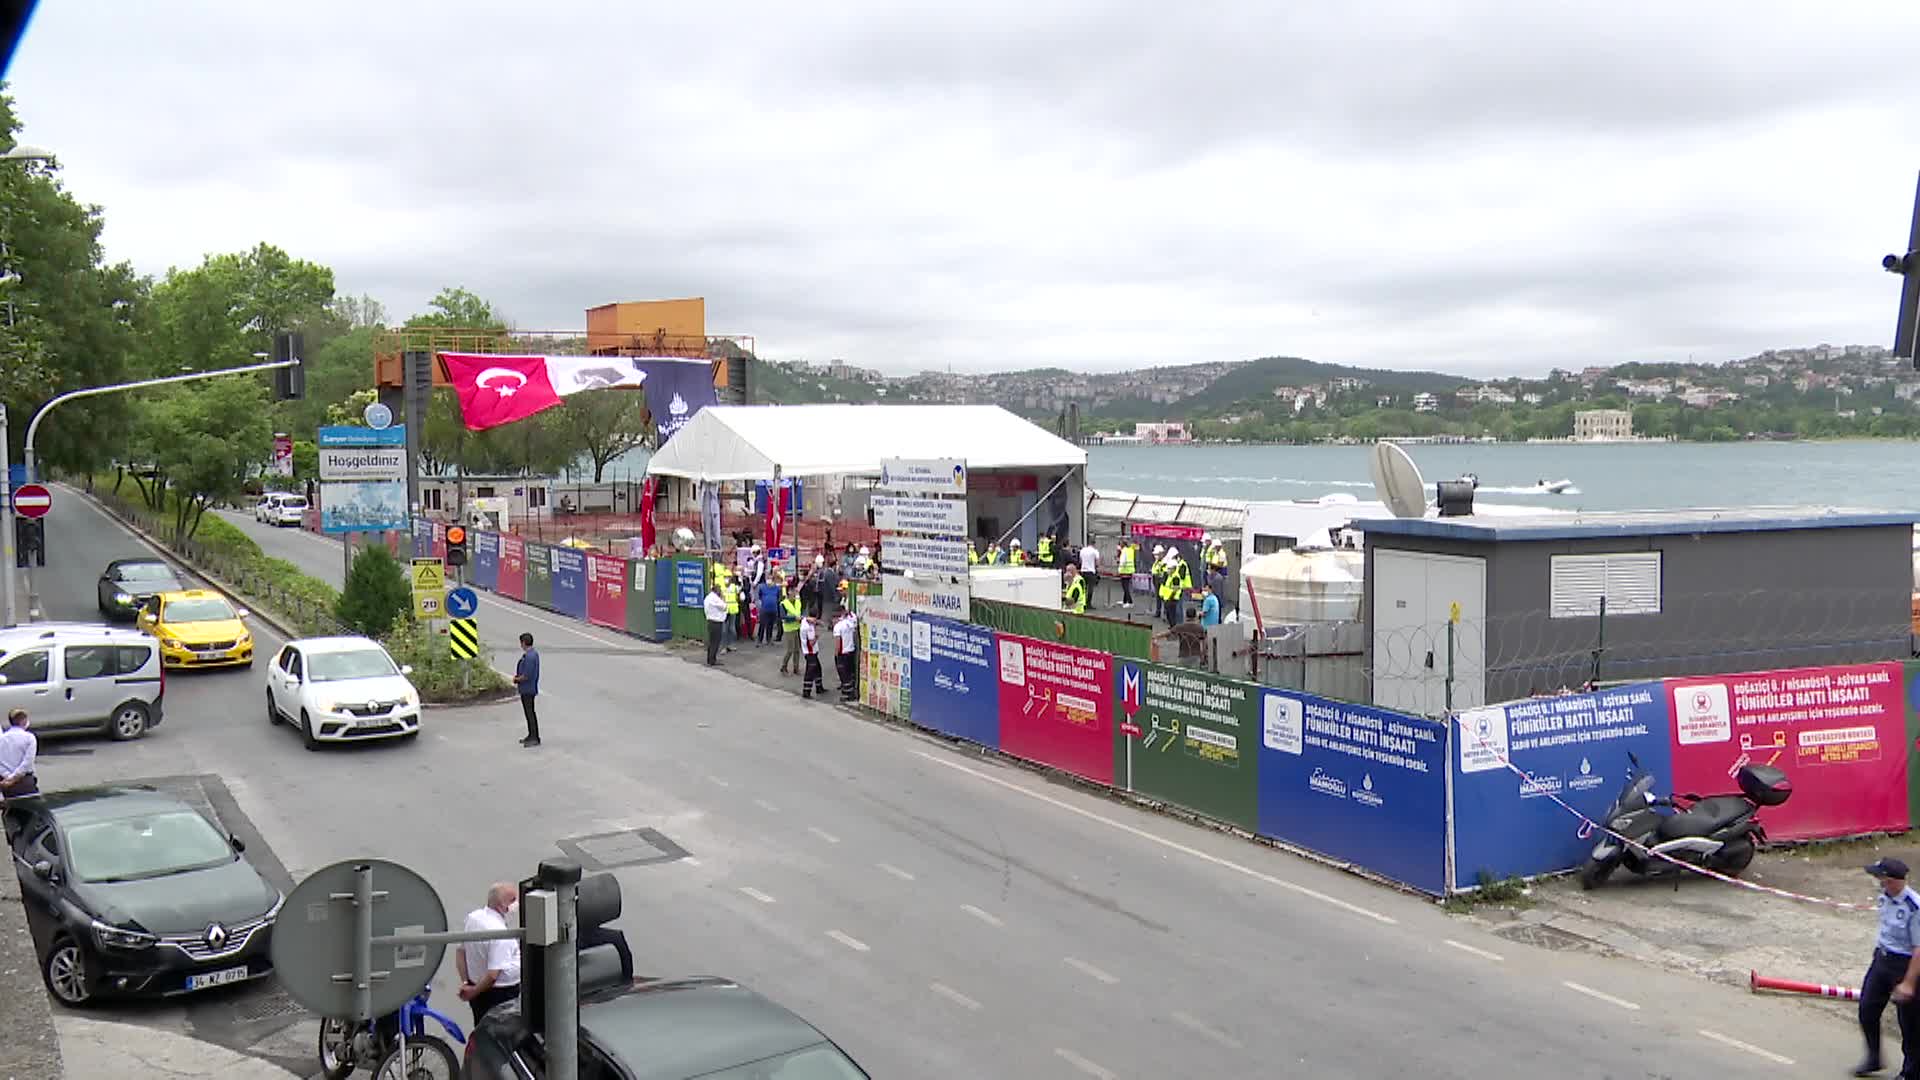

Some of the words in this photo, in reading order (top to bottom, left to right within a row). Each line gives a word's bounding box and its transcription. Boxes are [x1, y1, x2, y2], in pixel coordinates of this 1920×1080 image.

[423, 601, 437, 609] 20
[932, 593, 961, 611] ANKARA
[1123, 665, 1139, 706] M
[1733, 680, 1770, 694] BOĞAZİÇİ
[1787, 675, 1831, 690] HİSARÜSTÜ
[1837, 673, 1866, 688] AŞİYAN
[1866, 669, 1890, 685] SAHİL
[1183, 689, 1202, 705] HATTI
[1509, 702, 1541, 718] BOĞAZİÇİ
[1555, 696, 1597, 712] HİSARÜSTÜ
[1603, 692, 1629, 708] AŞİYAN
[1630, 689, 1653, 705] SAHİL
[1735, 692, 1794, 711] FÜNİKÜLER
[1796, 689, 1825, 706] HATTI
[1828, 687, 1869, 704] İNŞAATI
[1306, 703, 1334, 720] BOĞAZİÇİ
[1347, 711, 1383, 730] HİSARÜSTÜ
[1388, 720, 1413, 738] AŞİYAN
[1413, 727, 1436, 742] SAHİL
[1511, 714, 1563, 736] FÜNİKÜLER
[1565, 711, 1593, 729] HATTI
[1594, 706, 1633, 726] İNŞAATI
[1306, 717, 1351, 740] FÜNİKÜLER
[1352, 727, 1377, 746] HATTI
[1379, 730, 1416, 755] İNŞAATI
[1310, 776, 1346, 794] İMAMOĞLU
